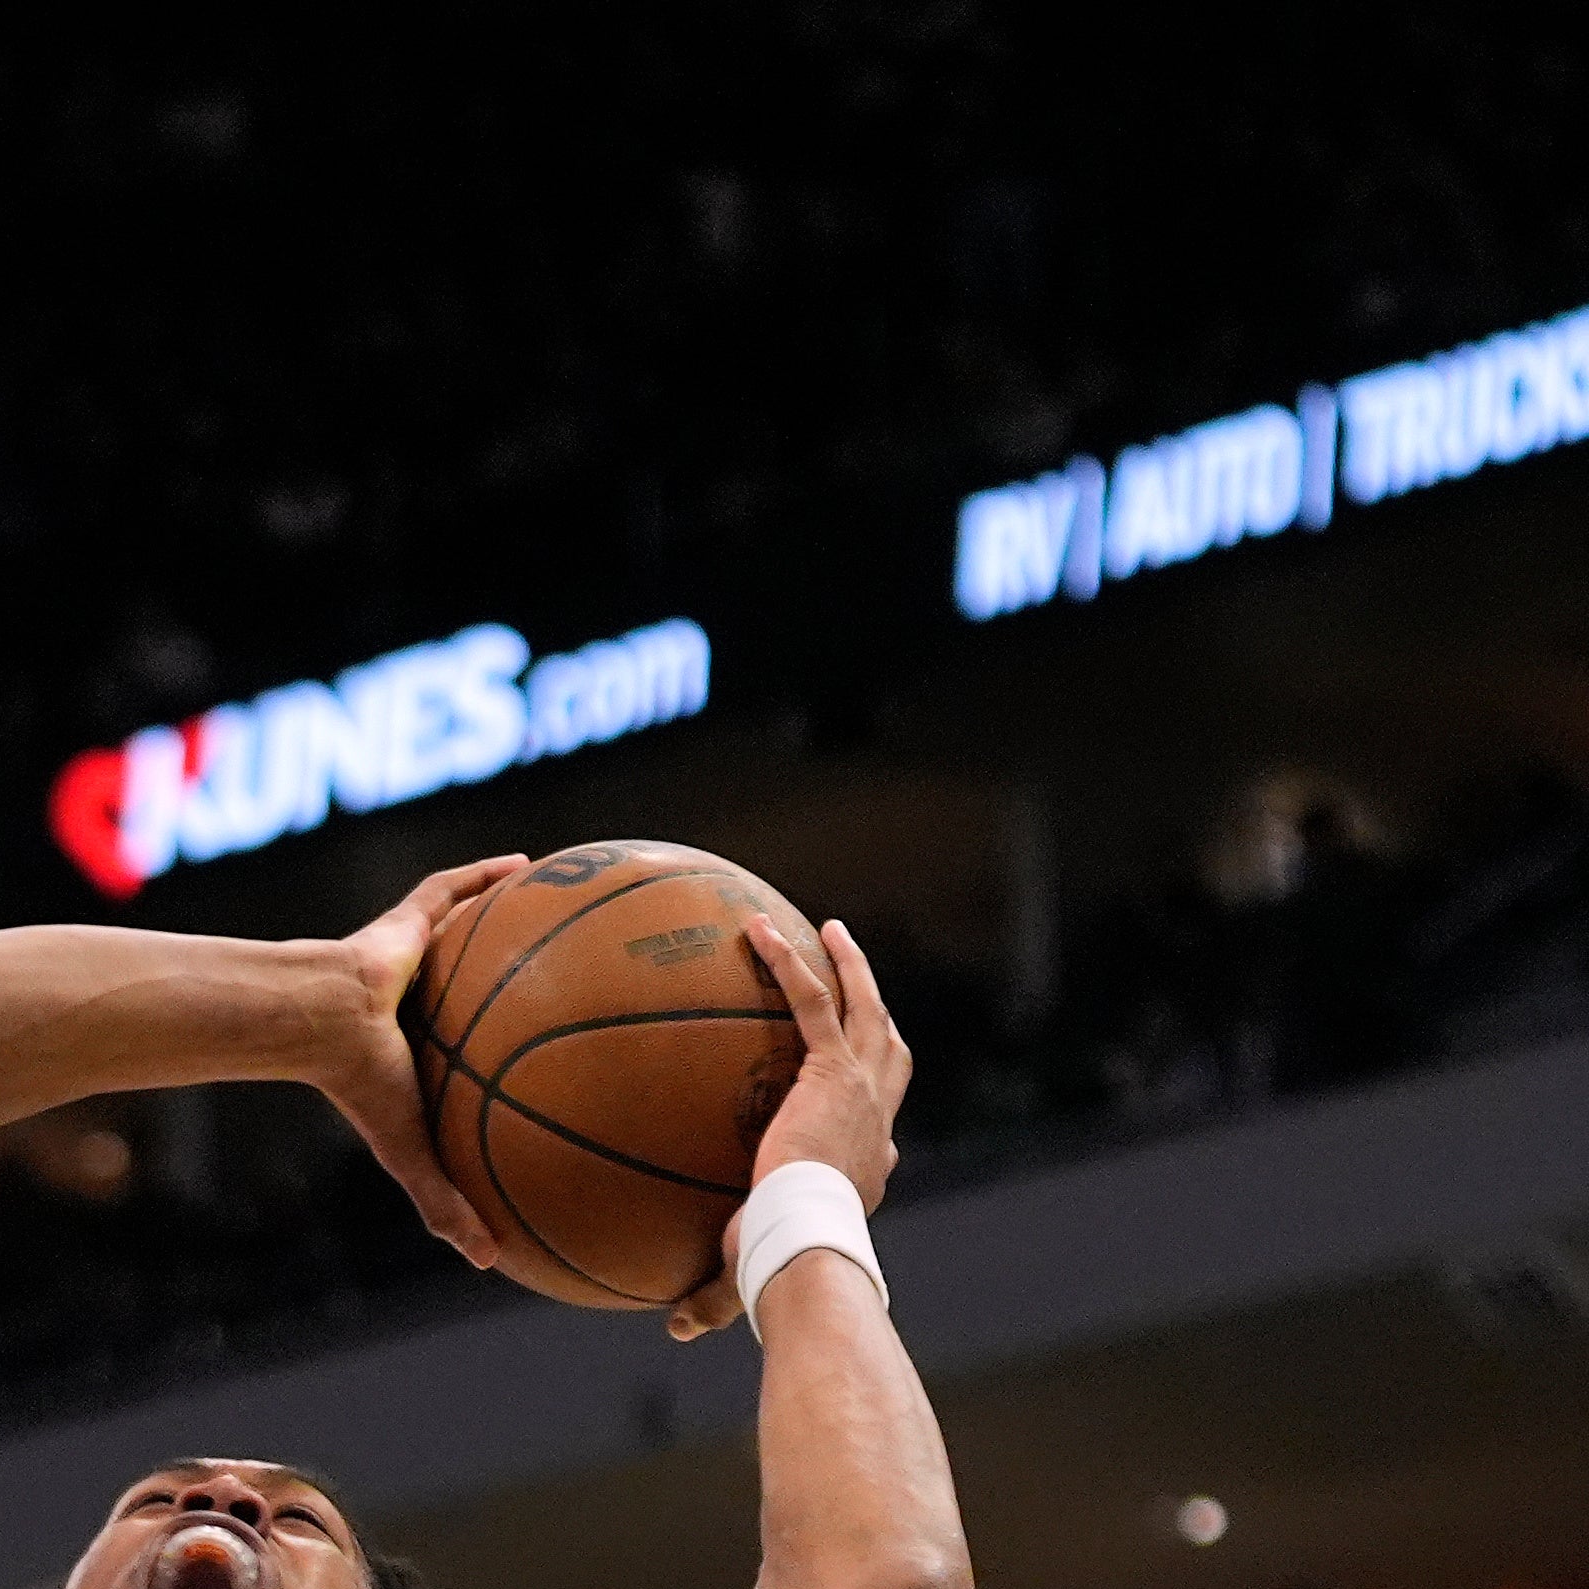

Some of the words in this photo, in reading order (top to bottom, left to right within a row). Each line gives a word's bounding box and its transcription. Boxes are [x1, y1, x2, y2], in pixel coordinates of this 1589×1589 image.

[955, 477, 1079, 619] RV
[1104, 406, 1304, 578] AUTO
[1341, 305, 1589, 502] TRUCK
